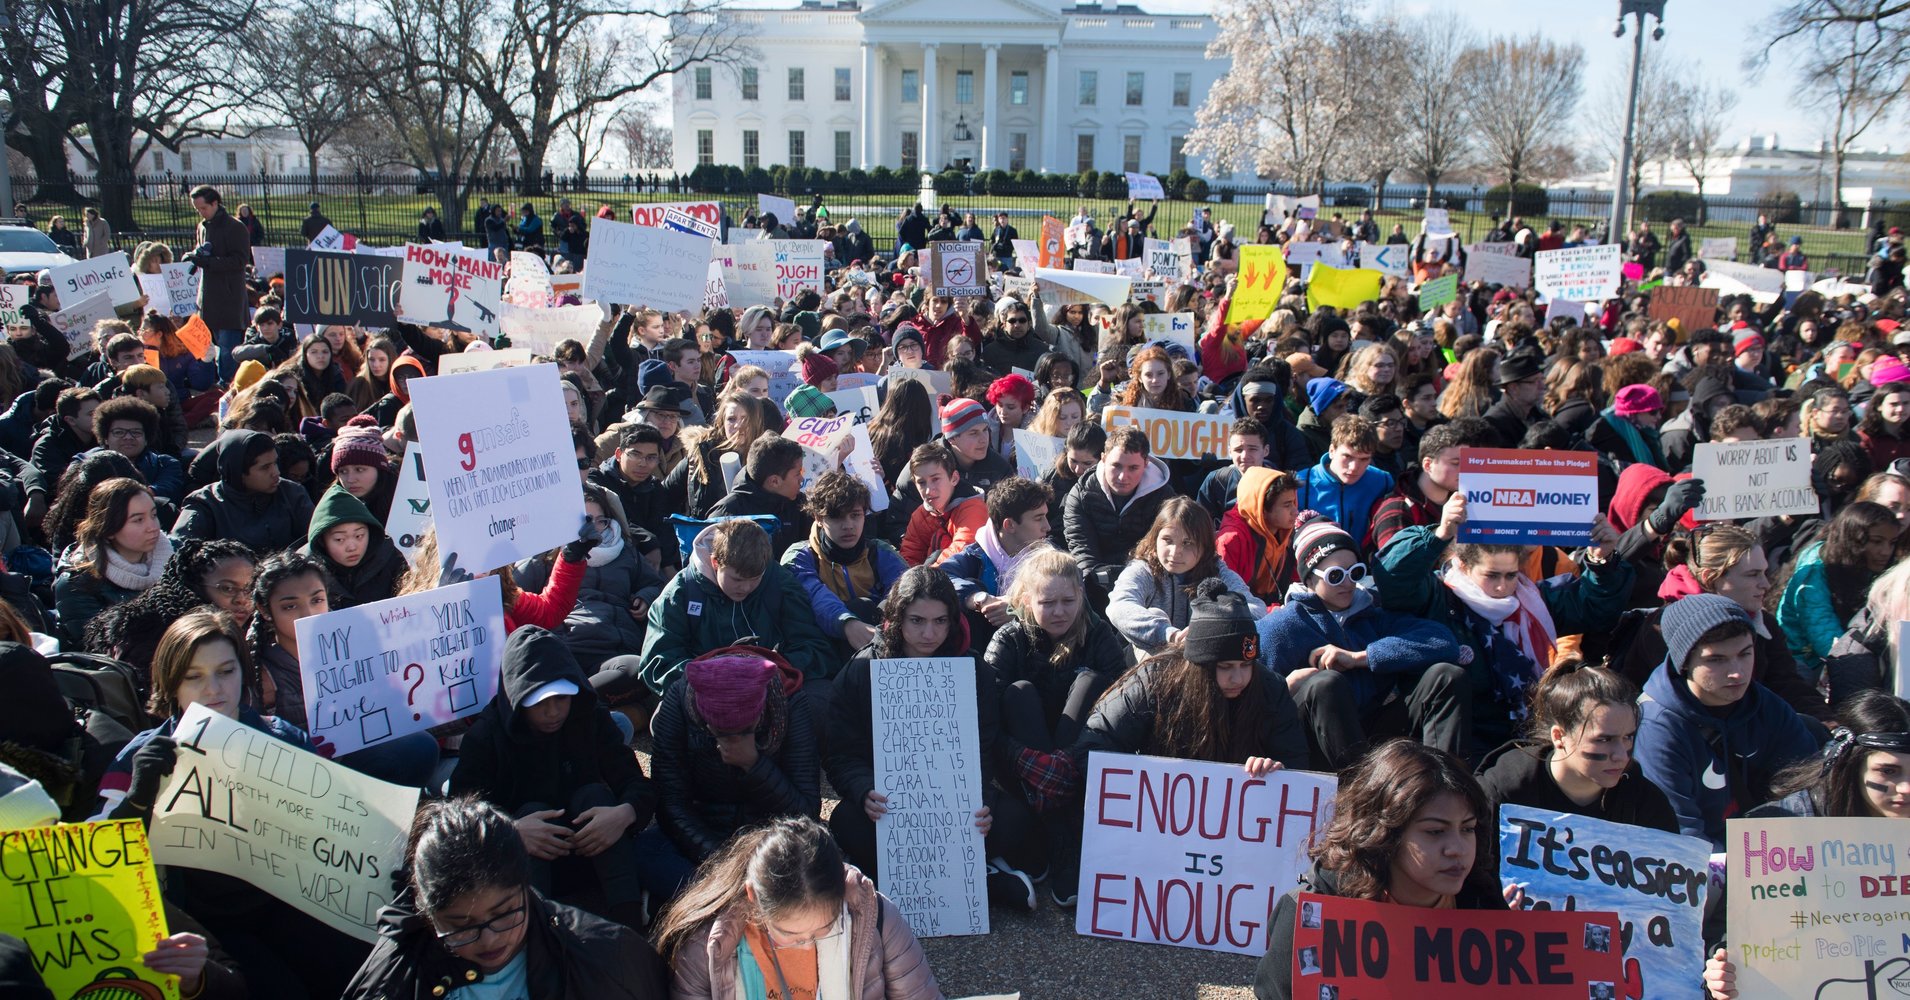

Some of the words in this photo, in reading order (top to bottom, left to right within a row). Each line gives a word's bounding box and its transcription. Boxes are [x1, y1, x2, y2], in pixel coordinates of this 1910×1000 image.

[635, 207, 665, 228] OUR
[668, 212, 715, 237] APARTMENTS
[775, 253, 788, 262] SAY
[791, 242, 813, 254] People
[939, 243, 952, 252] No
[955, 243, 979, 252] Guns
[407, 245, 450, 268] HOW
[458, 256, 502, 280] MANY
[1152, 252, 1178, 266] DON'T
[68, 266, 125, 292] g(un)safe
[429, 268, 473, 290] MORE
[951, 287, 985, 296] School!
[1558, 288, 1564, 298] I
[1568, 288, 1584, 297] AM
[1588, 286, 1602, 296] 17
[1172, 317, 1188, 330] for
[890, 371, 918, 380] FEAR
[798, 416, 847, 436] Guns
[1105, 410, 1230, 457] ENOUGH
[458, 406, 530, 471] gunsafe
[1468, 457, 1485, 466] Hey
[1487, 457, 1533, 466] Lawmakers!
[1566, 460, 1590, 468] Pledge!
[1717, 449, 1750, 466] WORRY
[1753, 446, 1780, 465] ABOUT
[1785, 444, 1797, 462] US
[443, 476, 467, 498] WHEN
[467, 471, 479, 489] THE
[1748, 472, 1769, 487] NOT
[448, 496, 473, 518] GUNS
[473, 488, 491, 509] SHOT
[1467, 490, 1492, 503] NO
[1495, 490, 1533, 505] NRA
[1536, 493, 1591, 505] MONEY
[1699, 496, 1727, 515] YOUR
[1735, 493, 1766, 513] BANK
[1770, 487, 1817, 509] ACCOUNTS
[488, 514, 516, 541] change
[379, 606, 416, 626] Which
[431, 599, 475, 633] YOUR
[689, 603, 701, 612] EF
[318, 625, 352, 665] MY
[430, 631, 470, 660] RIGHT
[471, 626, 487, 646] TO
[315, 656, 374, 699] RIGHT
[379, 650, 400, 675] TO
[439, 656, 480, 685] Kill
[879, 661, 923, 675] ALYSSA
[926, 661, 940, 674] A.
[941, 661, 952, 673] 14
[403, 663, 425, 721] ?
[878, 675, 919, 691] SCOTT
[925, 675, 937, 689] B.
[941, 675, 955, 688] 35
[945, 689, 956, 703] 14
[312, 696, 376, 734] Live
[946, 704, 957, 719] 17
[883, 721, 930, 738] JAMIE
[948, 720, 960, 735] 14
[883, 736, 927, 753] CHRIS
[931, 738, 944, 752] H.
[947, 736, 961, 750] 49
[180, 716, 212, 755] 1
[222, 727, 332, 798] CHILD
[338, 793, 369, 817] IS
[885, 754, 919, 772] LUKE
[924, 755, 938, 770] H.
[950, 753, 965, 769] 15
[884, 774, 923, 791] CARA
[927, 773, 941, 790] L.
[953, 774, 967, 789] 14
[213, 768, 270, 803] WORTH
[276, 798, 314, 821] MORE
[322, 815, 360, 838] THAN
[956, 793, 971, 809] 14
[1098, 767, 1320, 853] ENOUGH
[165, 766, 248, 833] ALL
[253, 818, 272, 838] OF
[277, 827, 307, 851] THE
[313, 837, 380, 879] GUNS
[958, 812, 971, 826] 17
[960, 828, 972, 843] 14
[0, 821, 144, 881] CHANGE
[887, 846, 936, 863] MEADOW
[938, 846, 949, 863] P.
[962, 846, 976, 861] 18
[1744, 830, 1815, 878] How
[1821, 839, 1897, 876] many
[888, 864, 936, 880] HELENA
[939, 864, 951, 878] R.
[964, 862, 975, 878] 17
[1184, 852, 1224, 876] IS
[1506, 817, 1590, 881] It's
[1591, 844, 1708, 907] easier
[165, 824, 216, 851] IN
[224, 832, 287, 878] THE
[296, 863, 386, 927] WORLD
[889, 882, 920, 895] ALEX
[924, 880, 936, 895] S.
[964, 878, 975, 893] 14
[1751, 876, 1807, 900] need
[1821, 873, 1846, 900] to
[940, 896, 950, 908] S.
[966, 895, 980, 909] 16
[968, 911, 981, 925] 15
[969, 926, 981, 934] 37
[1648, 915, 1674, 947] a
[23, 928, 120, 973] WAS
[1322, 919, 1389, 980] NO
[1414, 925, 1574, 986] MORE
[1741, 937, 1802, 968] protect
